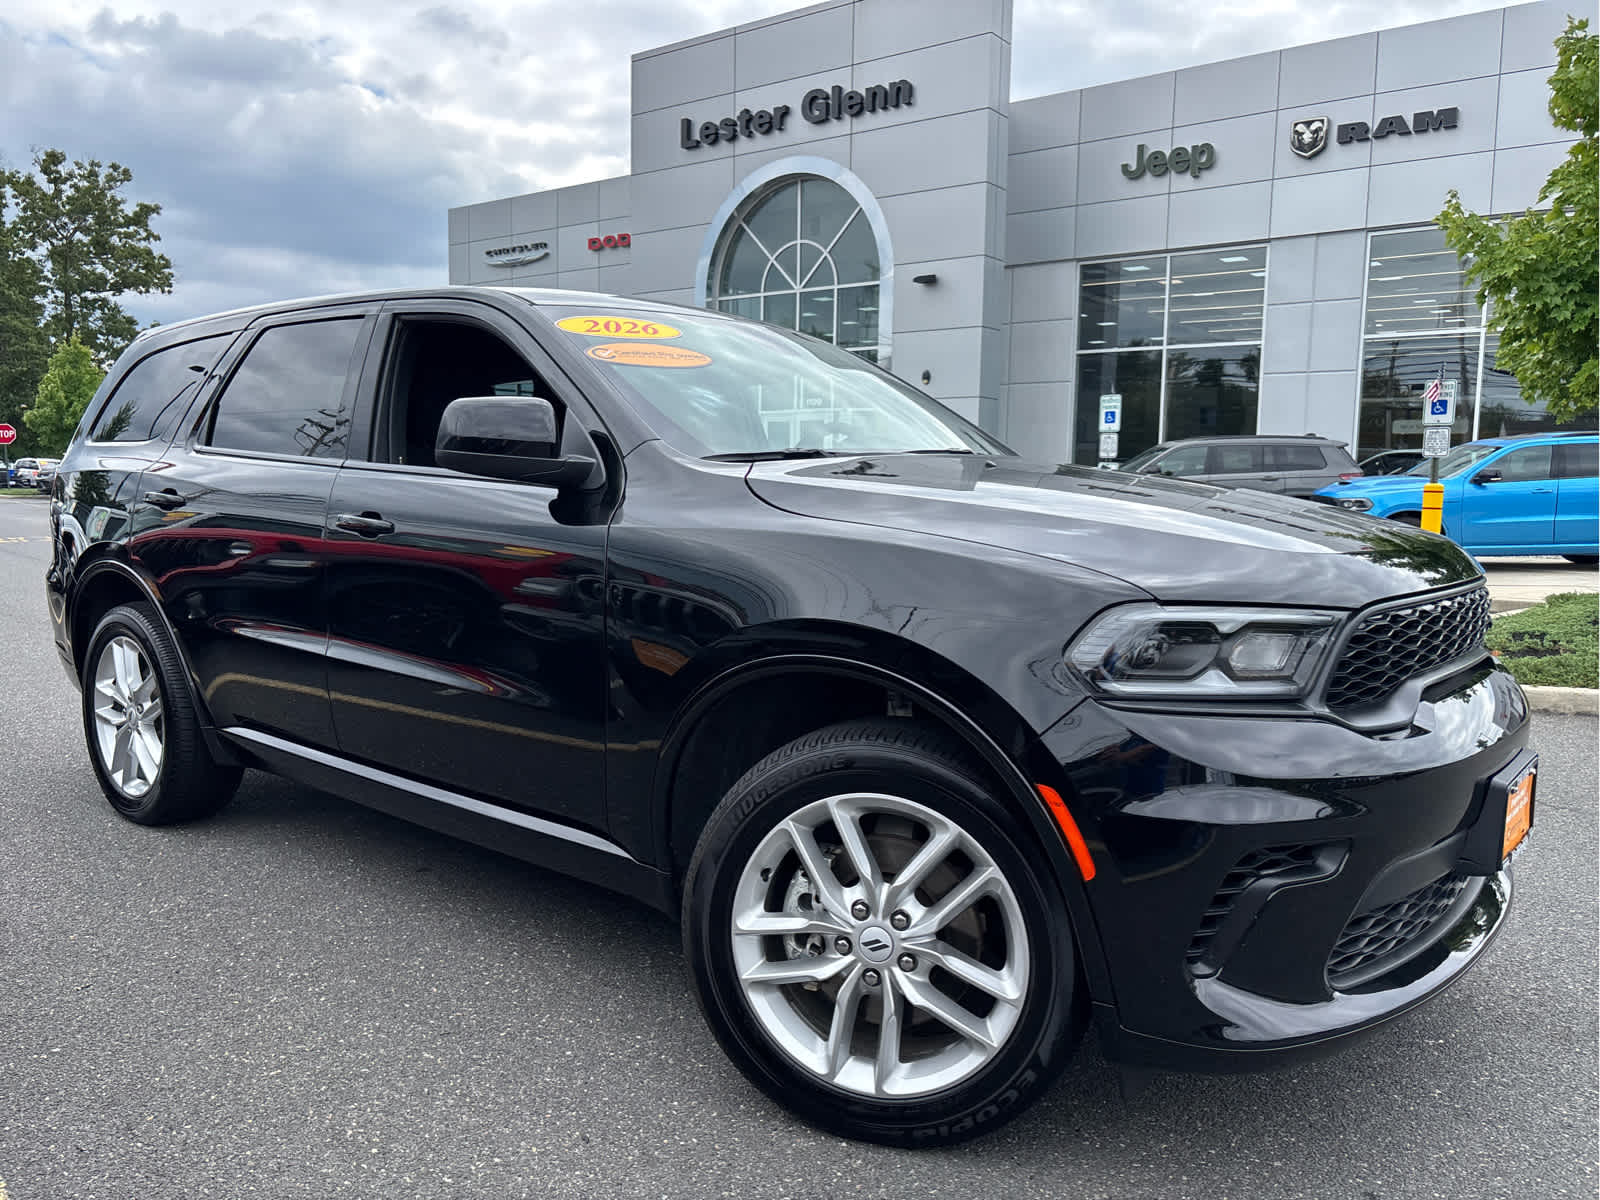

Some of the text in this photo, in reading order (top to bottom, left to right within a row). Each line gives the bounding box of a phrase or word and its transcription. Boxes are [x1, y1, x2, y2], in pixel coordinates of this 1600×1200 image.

[681, 79, 913, 150] Lester Glenn
[1337, 107, 1458, 144] RAM
[1121, 142, 1217, 179] Jeep
[583, 319, 659, 335] 2026
